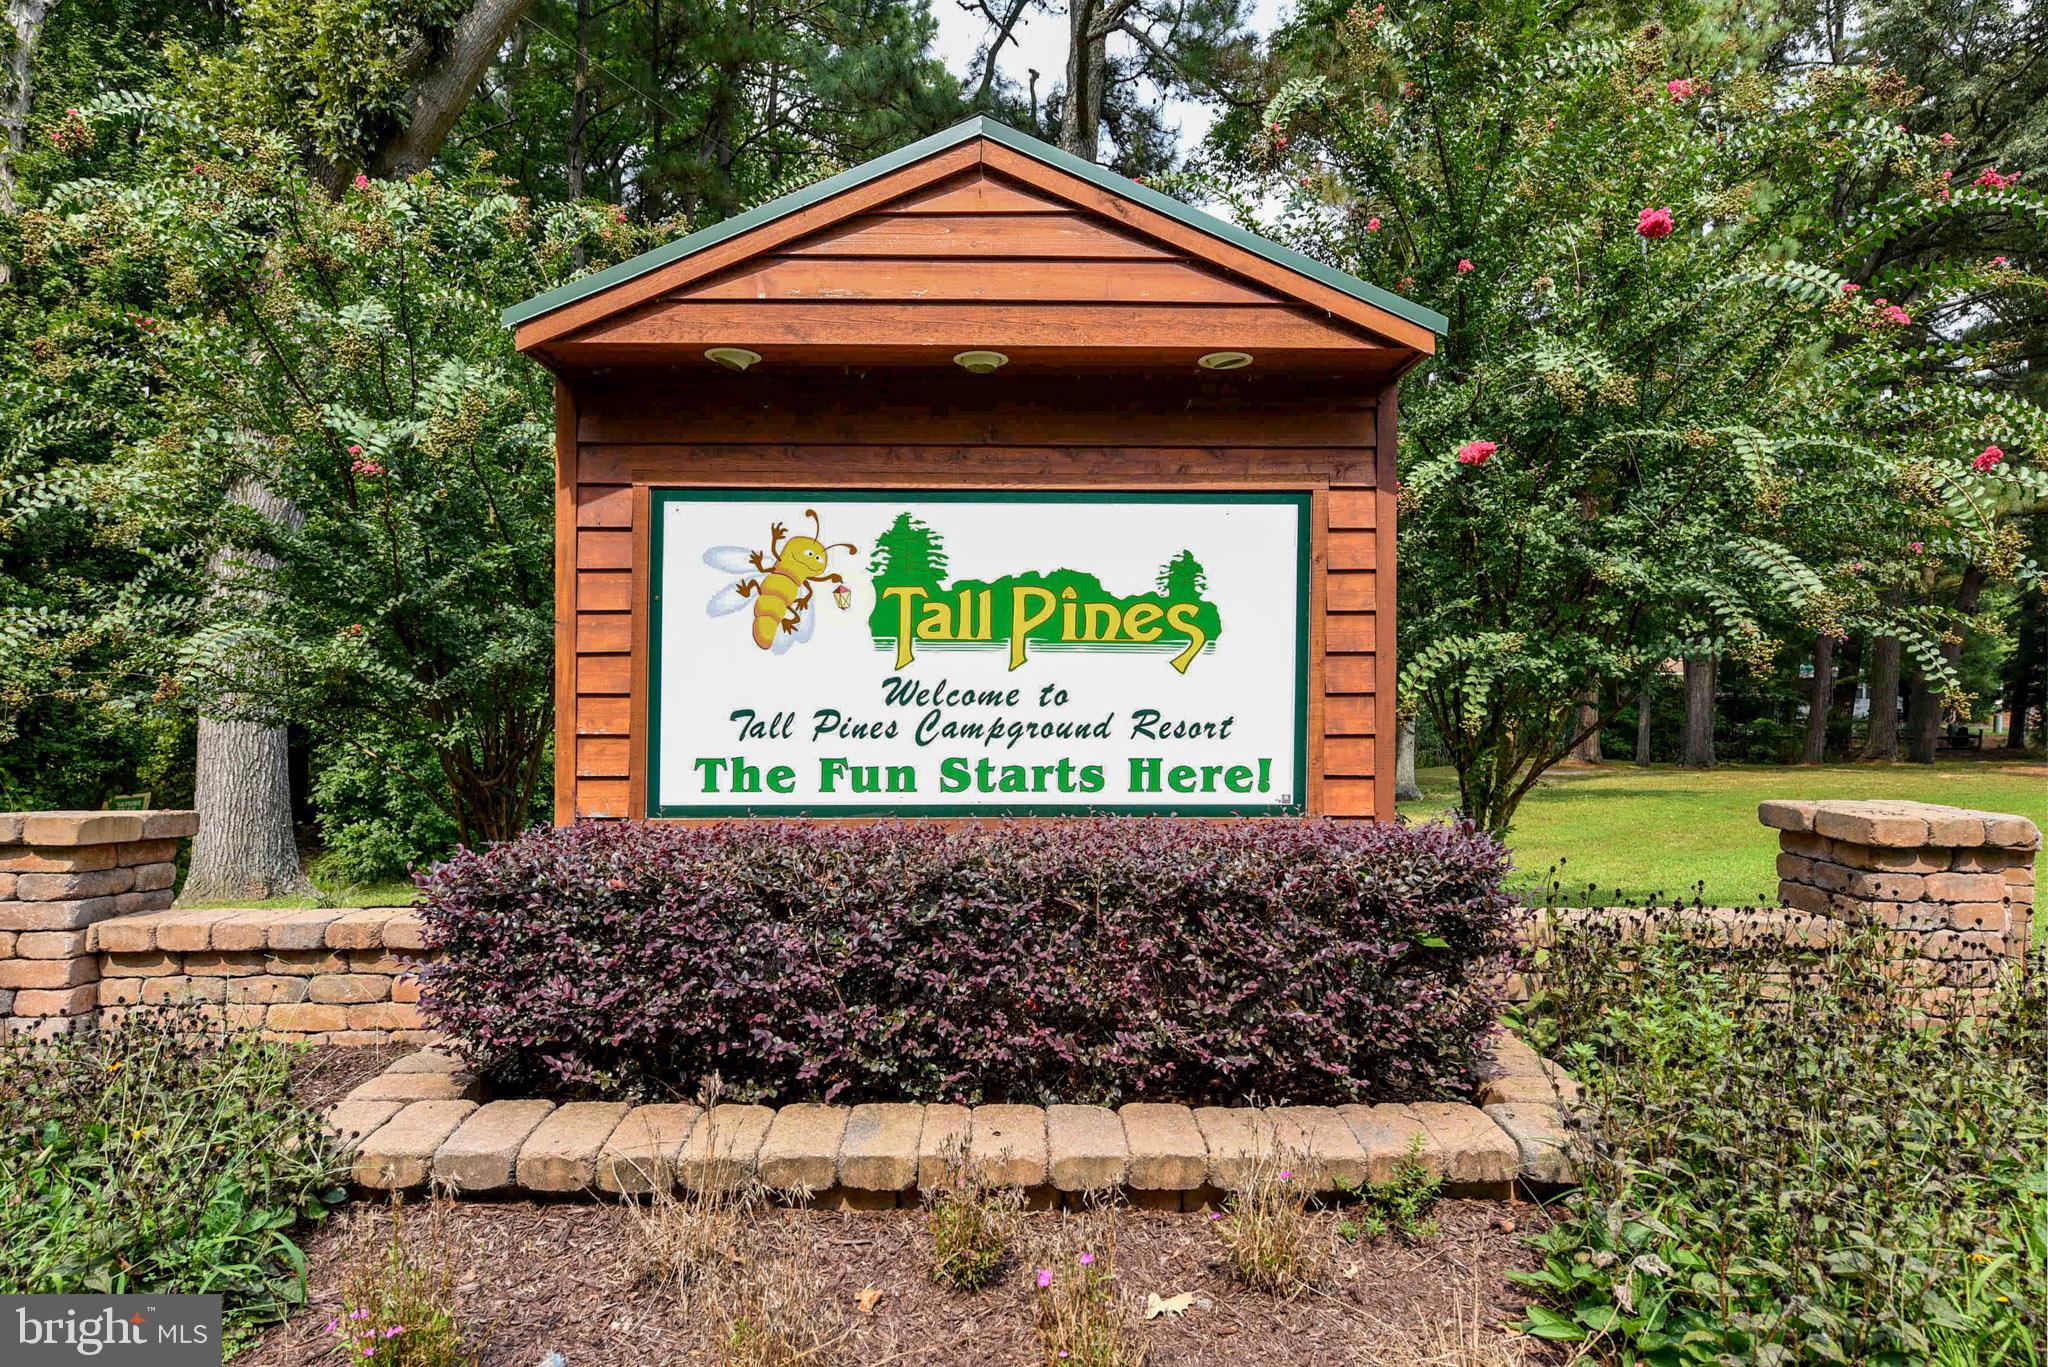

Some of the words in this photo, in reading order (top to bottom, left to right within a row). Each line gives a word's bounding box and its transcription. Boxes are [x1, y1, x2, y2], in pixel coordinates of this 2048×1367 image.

[882, 585, 993, 671] Tall
[1008, 584, 1206, 675] Pines
[881, 677, 1020, 708] Welcome
[1040, 683, 1069, 707] to
[729, 709, 795, 742] Tall
[813, 710, 899, 742] Pines
[914, 709, 1113, 750] Campground
[1130, 709, 1235, 742] Resort
[694, 756, 796, 793] The
[818, 757, 918, 793] Fun
[939, 757, 1106, 793] Starts
[1127, 757, 1273, 793] Here!
